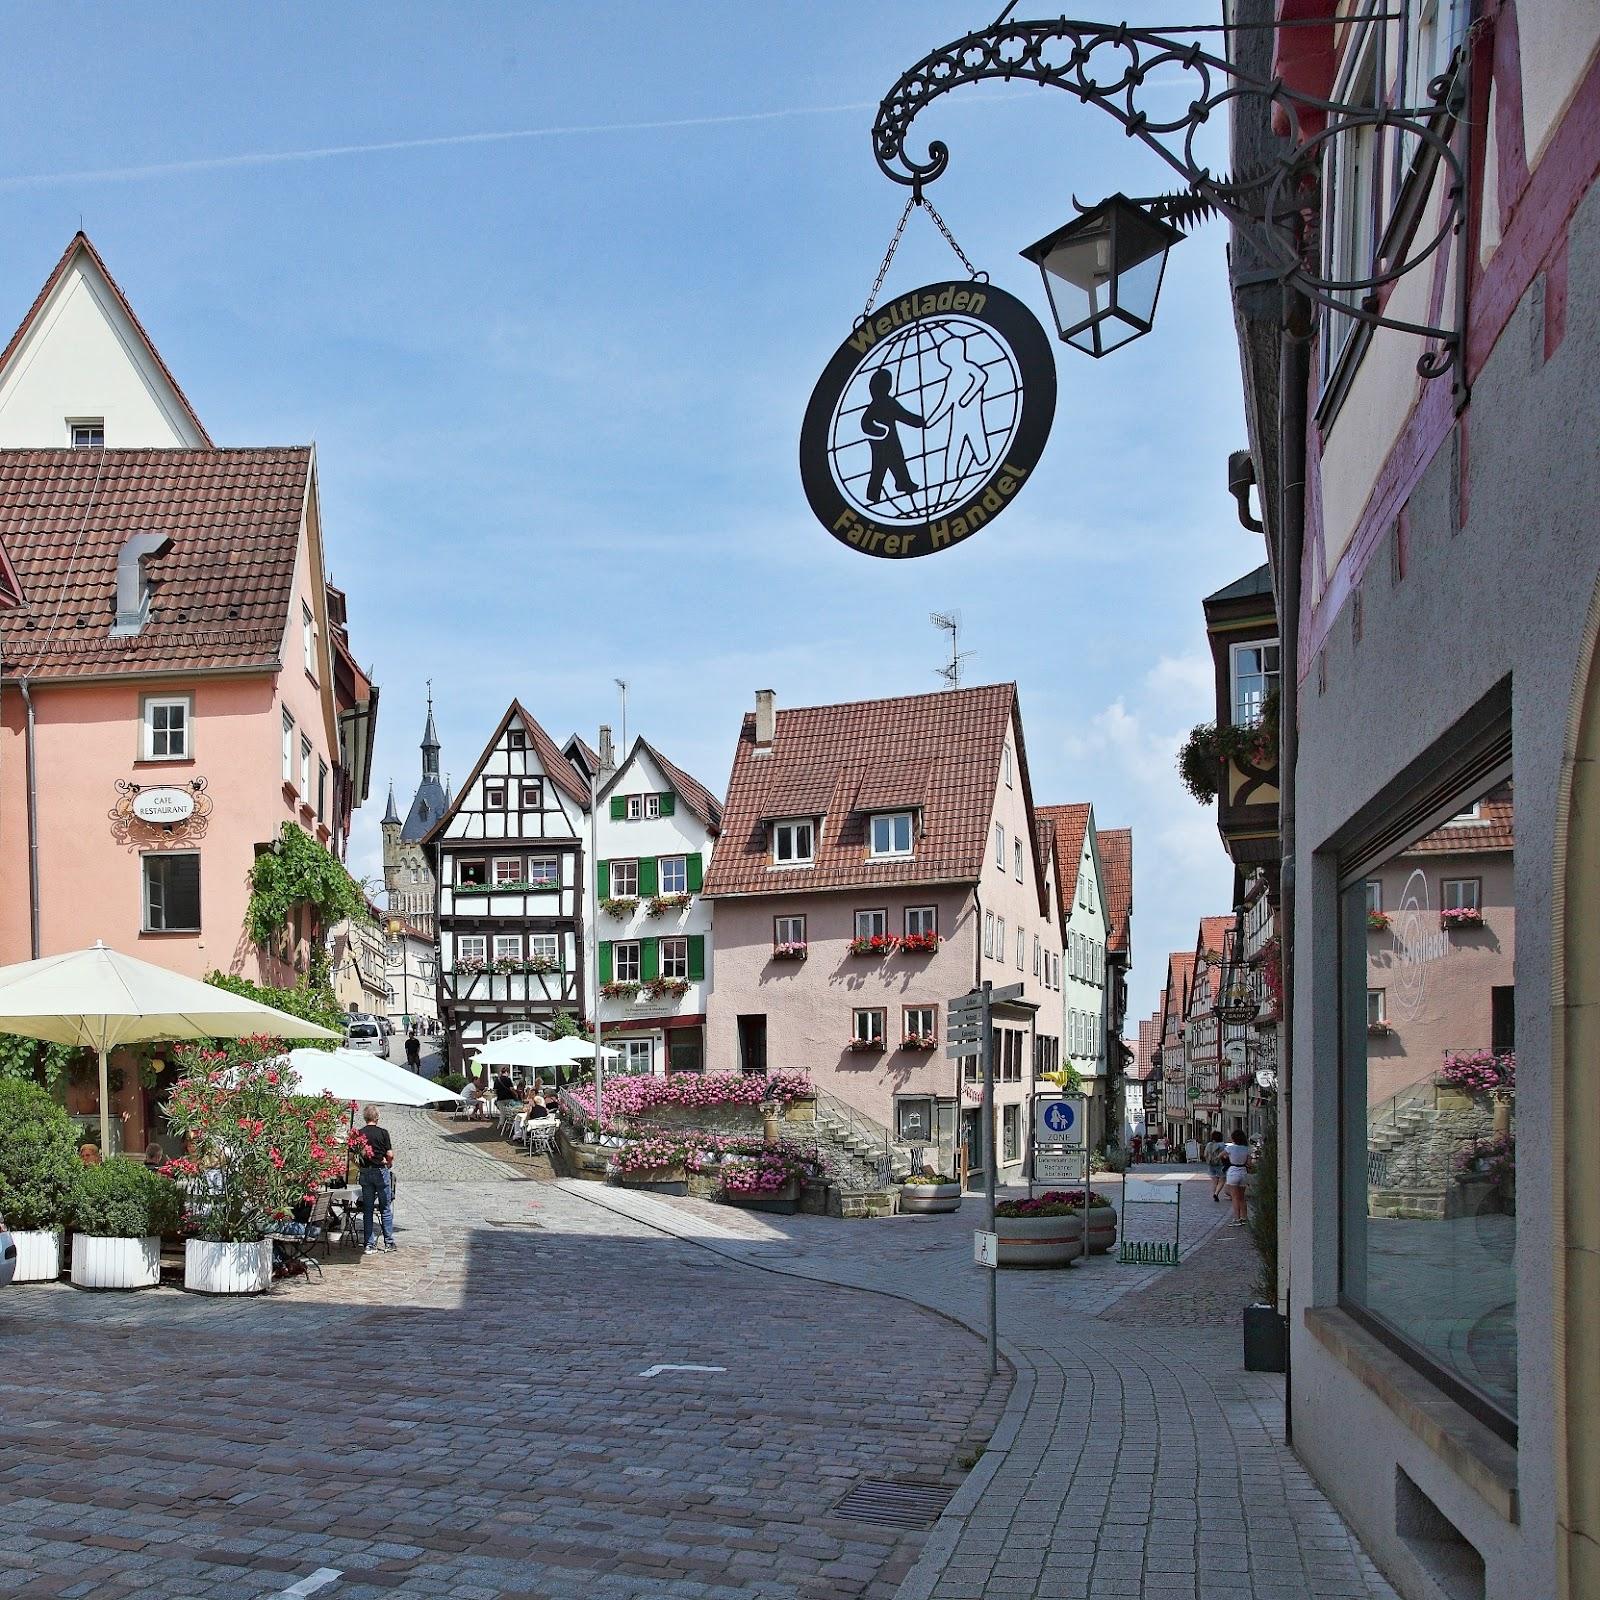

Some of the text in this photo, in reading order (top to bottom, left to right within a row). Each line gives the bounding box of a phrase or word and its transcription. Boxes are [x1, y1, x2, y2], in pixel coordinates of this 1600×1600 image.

[848, 285, 988, 355] Weltladen
[833, 463, 1028, 554] Fairer Handel
[140, 806, 188, 814] RESTAURANT
[1047, 1133, 1071, 1141] ZONE
